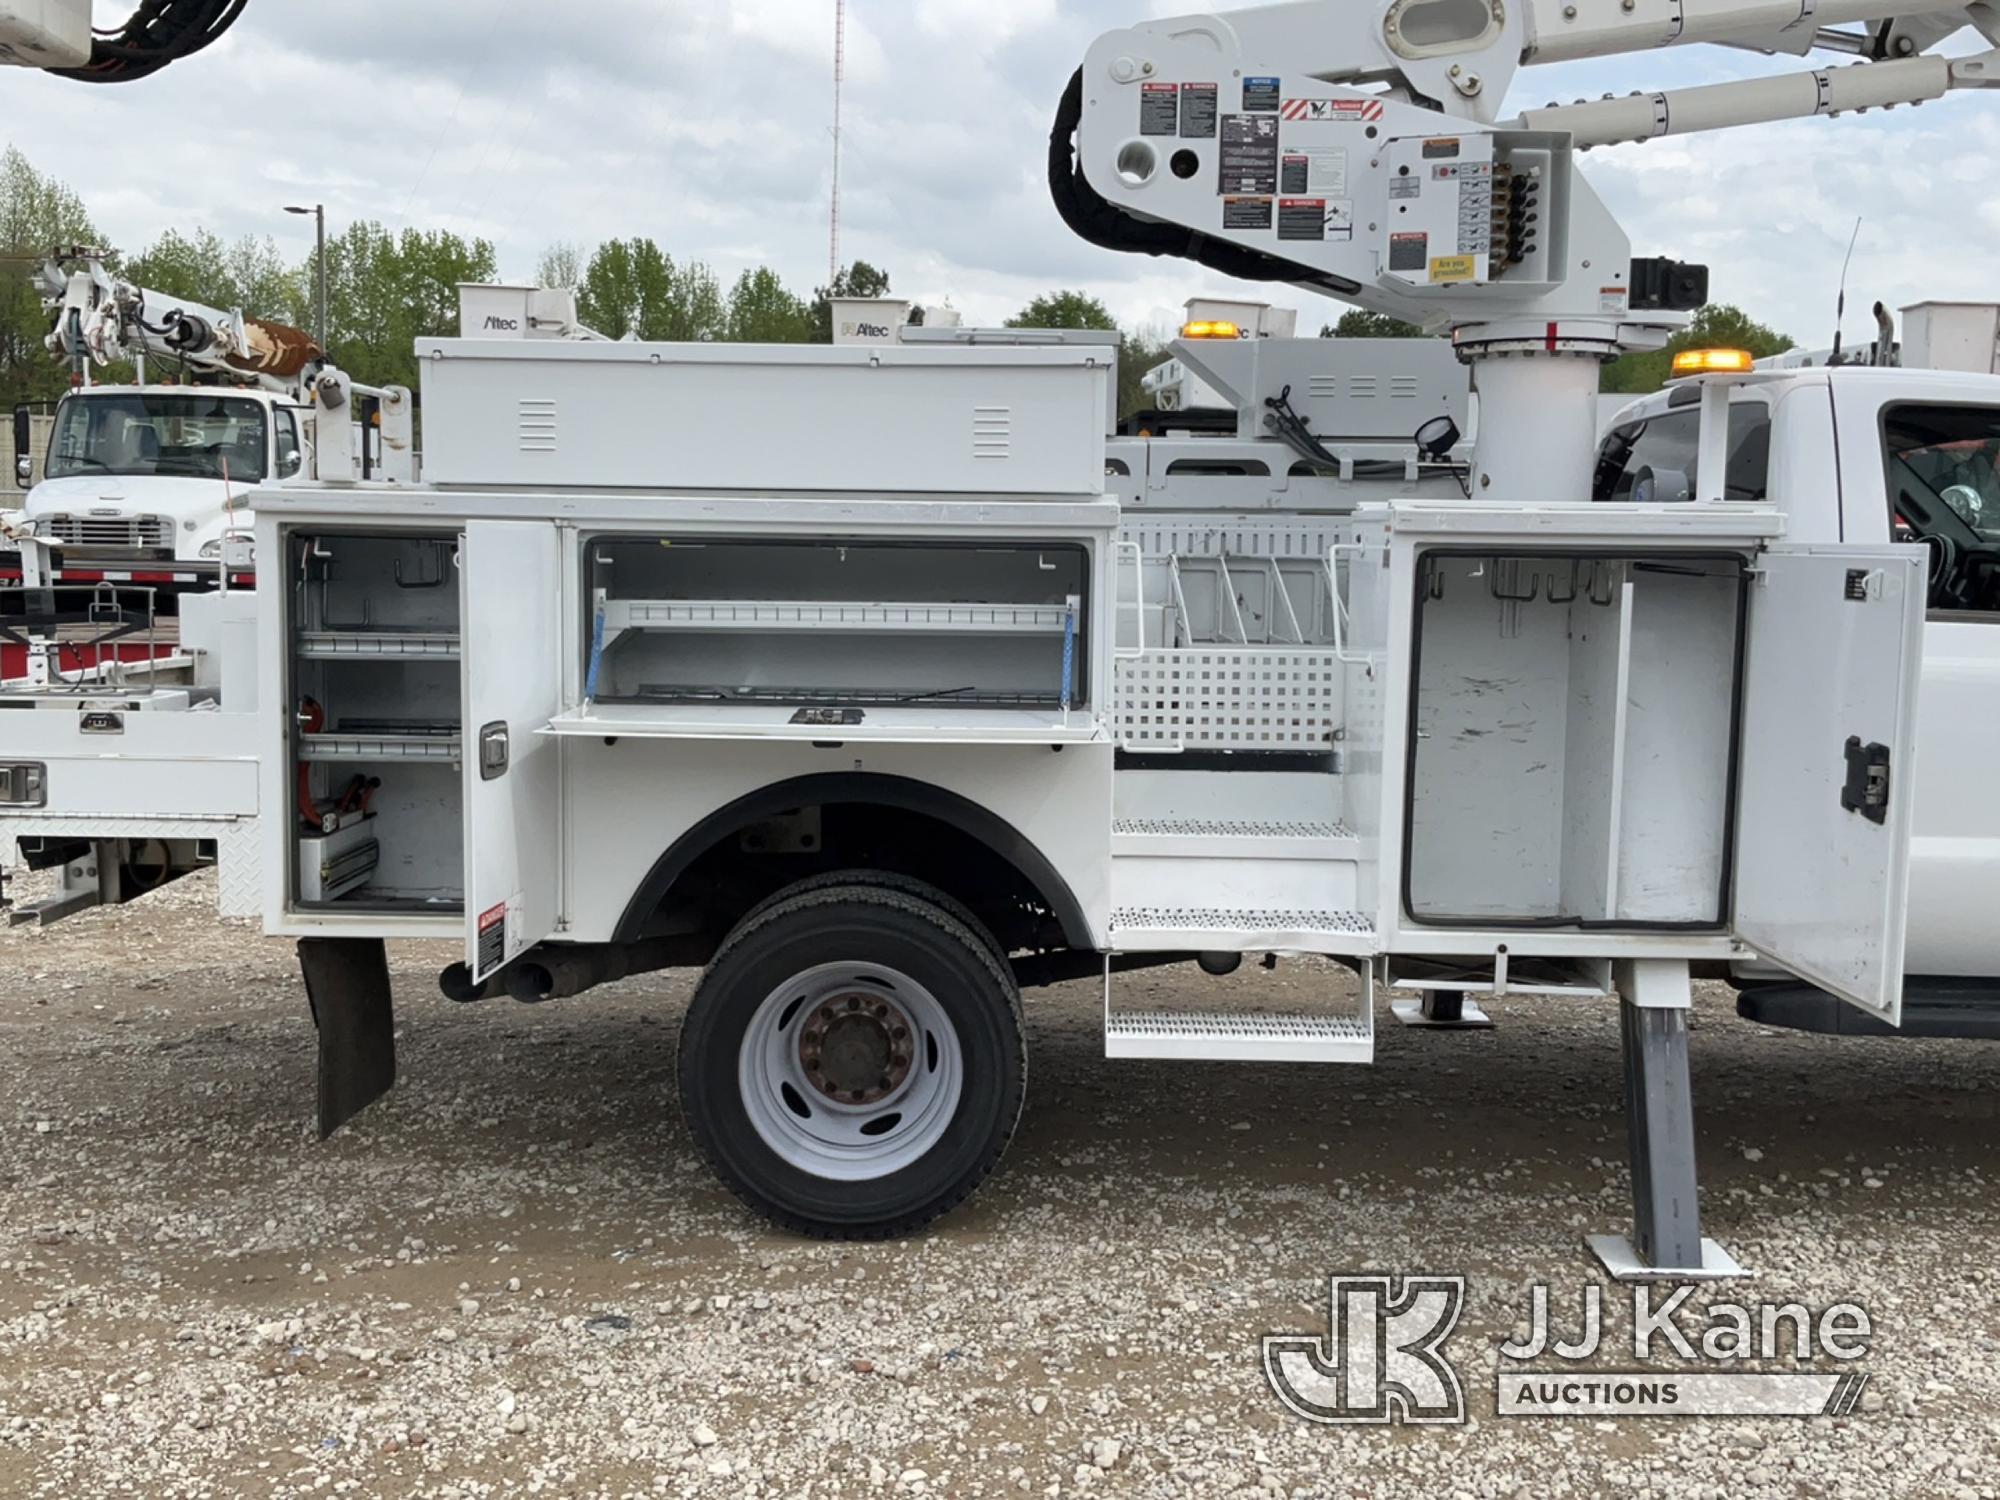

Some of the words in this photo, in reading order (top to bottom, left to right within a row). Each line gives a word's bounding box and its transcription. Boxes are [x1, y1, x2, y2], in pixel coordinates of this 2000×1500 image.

[1452, 260, 1464, 269] you
[1433, 266, 1470, 279] grounded?
[484, 316, 517, 331] Altec
[857, 323, 889, 337] Altec
